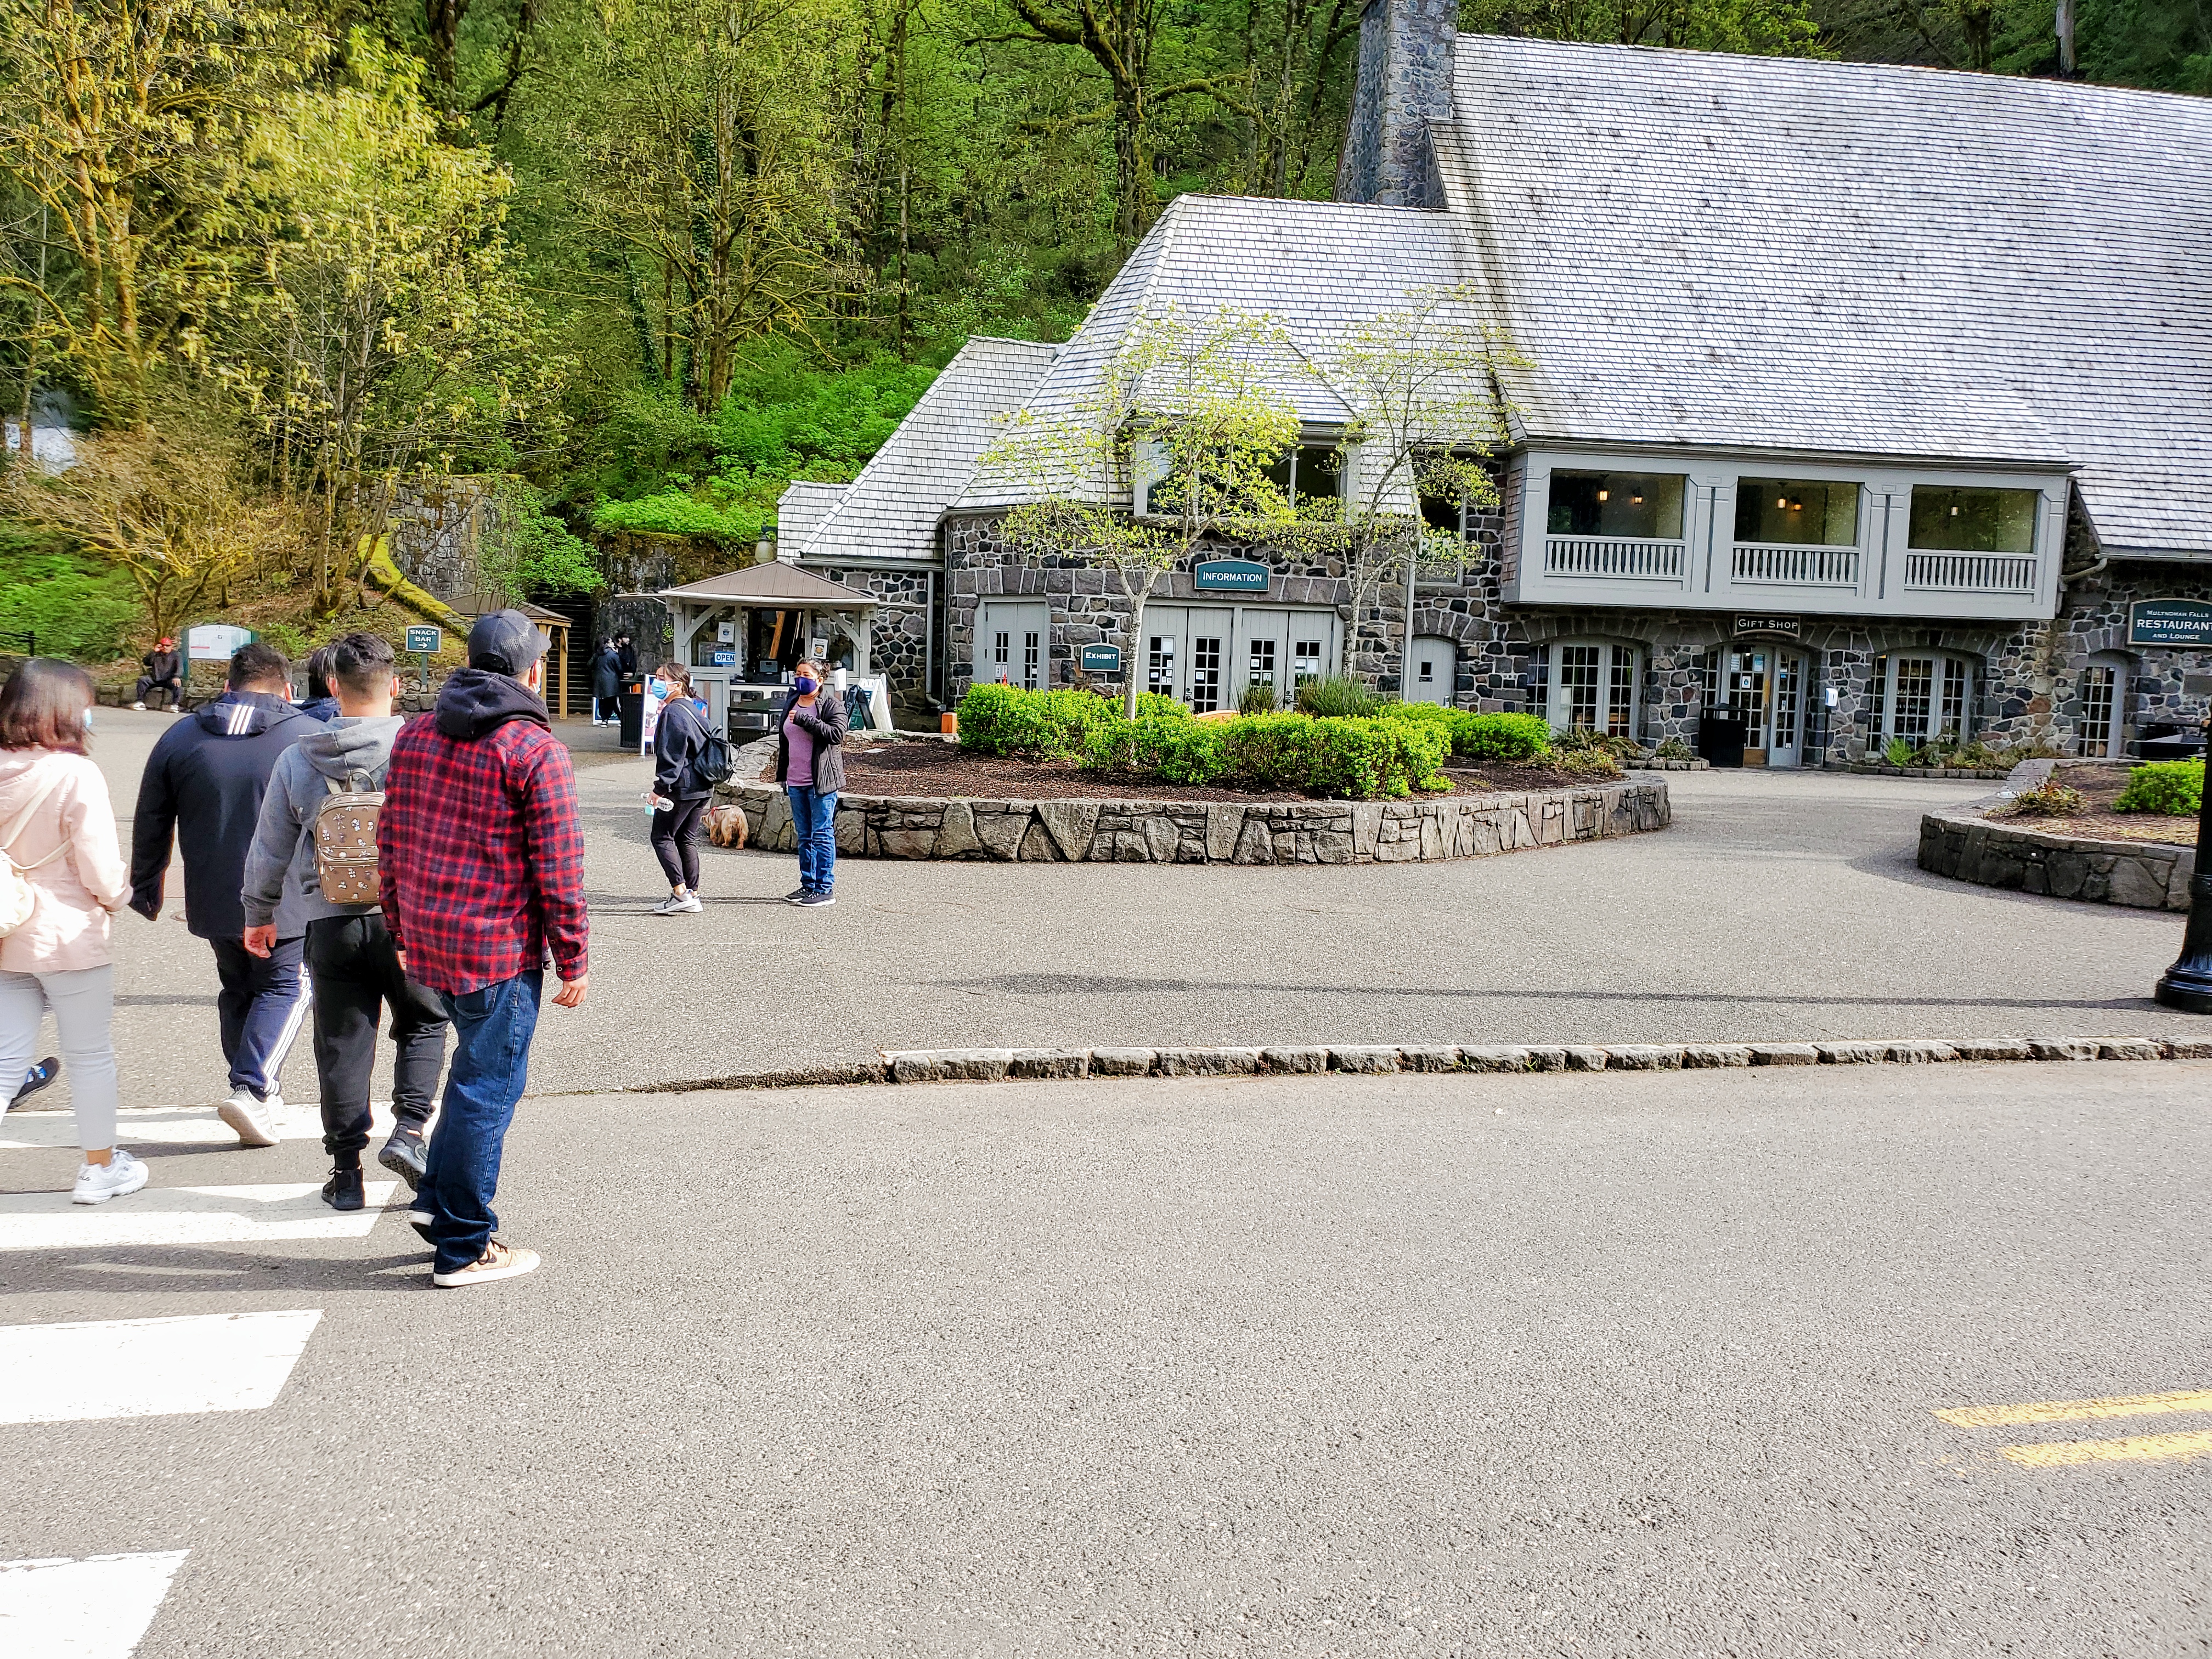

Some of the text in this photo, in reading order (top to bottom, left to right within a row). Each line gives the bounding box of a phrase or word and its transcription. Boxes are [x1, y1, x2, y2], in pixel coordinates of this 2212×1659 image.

[1203, 571, 1262, 582] INFORMATION
[1738, 619, 1798, 629] GIFT SHOP
